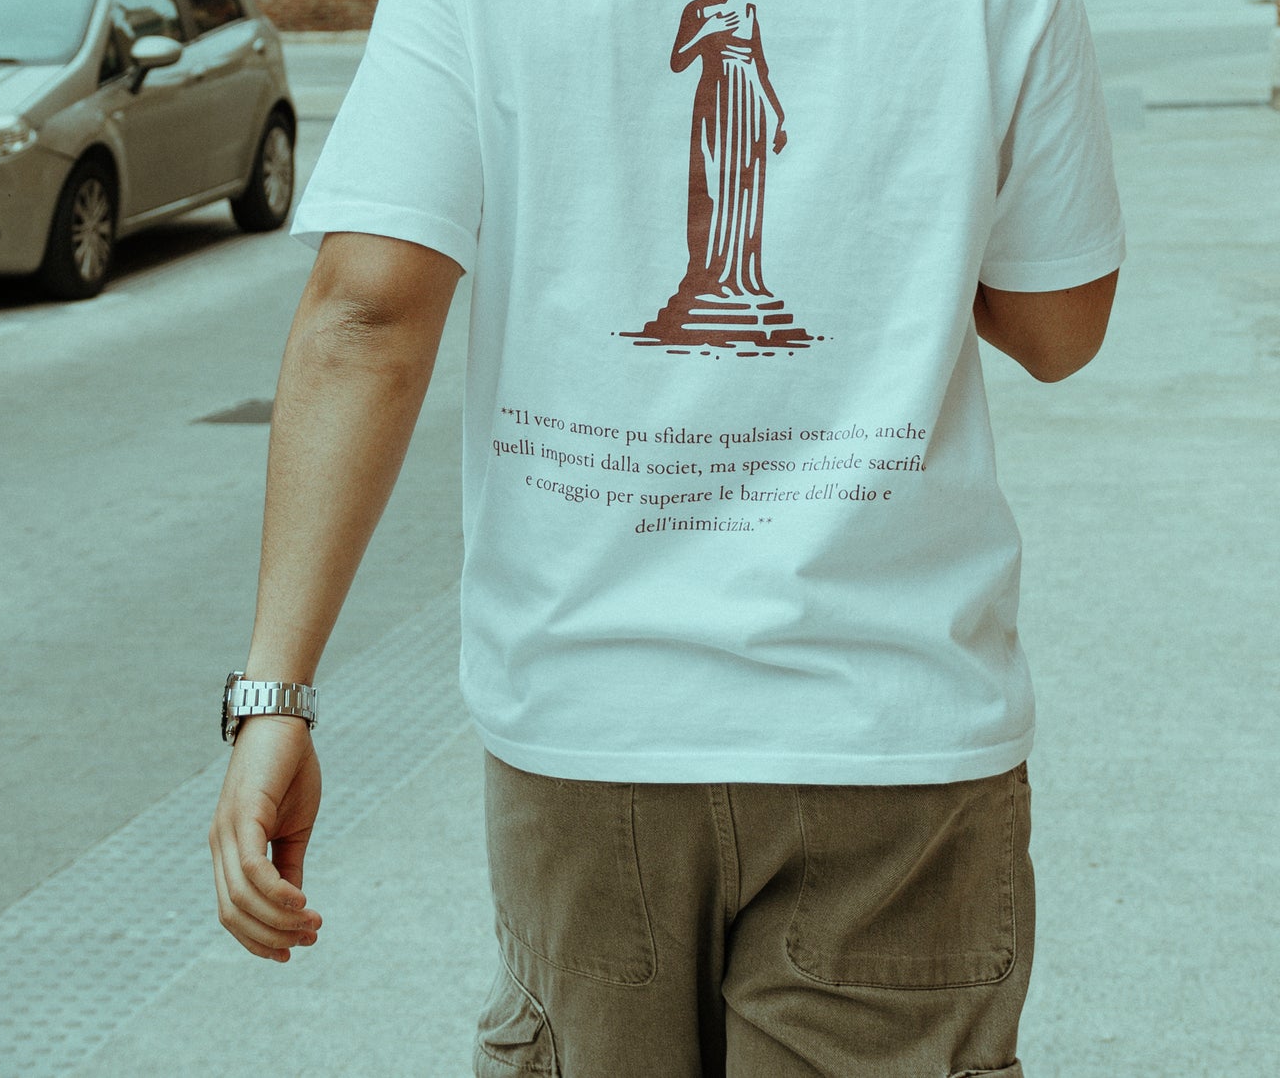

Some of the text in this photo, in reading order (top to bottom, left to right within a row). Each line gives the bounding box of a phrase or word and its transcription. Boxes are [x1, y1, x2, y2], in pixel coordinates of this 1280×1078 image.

[534, 416, 565, 430] vero
[570, 422, 619, 439] amore
[626, 430, 647, 446] pu
[654, 427, 713, 444] sfidare
[719, 427, 792, 448] qualsiasi
[800, 424, 869, 441] ostacolo,
[875, 423, 926, 440] anche
[493, 438, 535, 456] quelli
[541, 443, 594, 467] imposti
[601, 454, 640, 473] dalla
[646, 461, 703, 476] societ,
[710, 462, 736, 473] ma
[742, 460, 796, 475] spesso
[802, 453, 862, 471] richiede
[525, 474, 892, 509] e coraggio per superare le barriere dell'odio e
